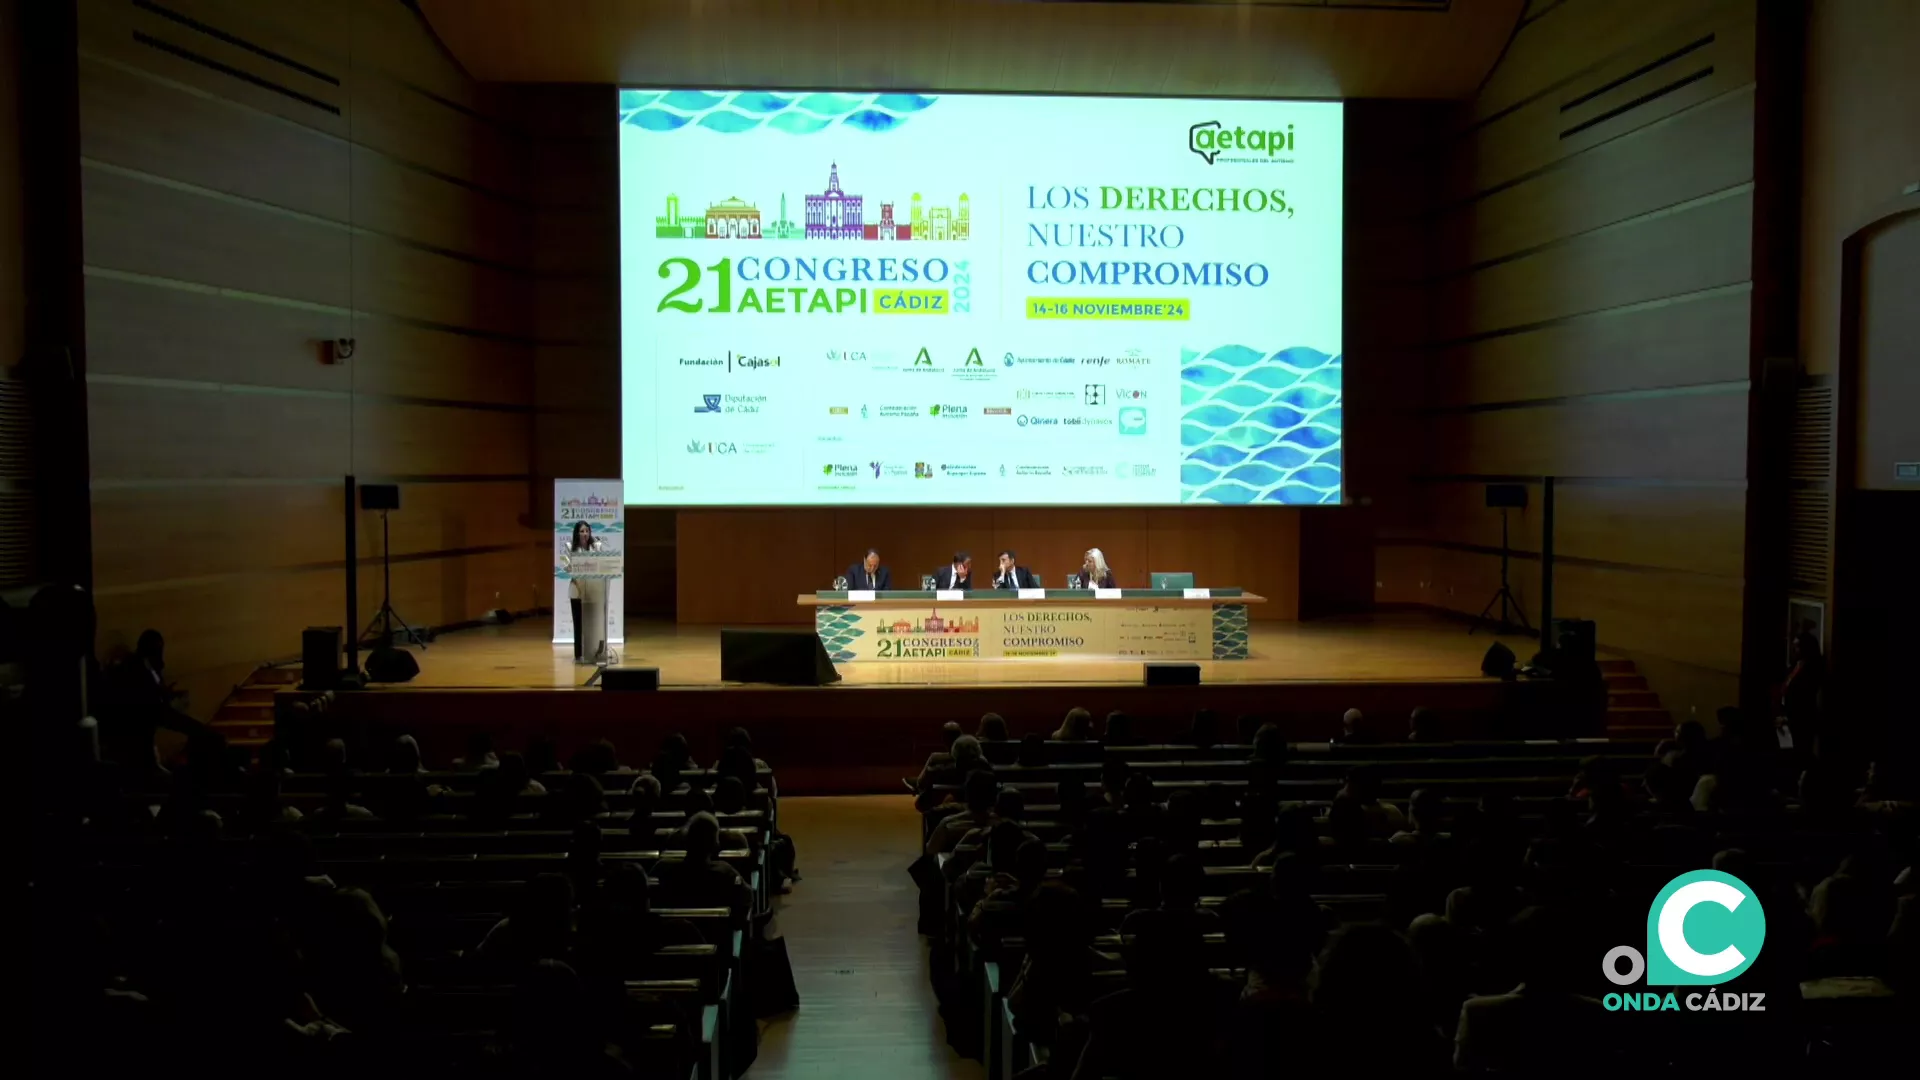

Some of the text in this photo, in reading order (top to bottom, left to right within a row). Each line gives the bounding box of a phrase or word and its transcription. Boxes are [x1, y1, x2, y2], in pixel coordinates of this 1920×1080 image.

[1195, 124, 1294, 156] aetapi
[1028, 185, 1294, 219] LOS DERECHOS,
[1027, 223, 1185, 248] NUESTRO
[737, 256, 949, 282] CONGRESO
[1027, 260, 1269, 287] COMPROMISO
[657, 257, 731, 313] 21
[953, 260, 971, 312] 2024
[737, 288, 943, 313] AETAPI CÁDIZ
[1033, 303, 1068, 315] 14-16
[738, 356, 780, 370] Cajasol
[1081, 356, 1110, 367] renfe
[942, 404, 968, 413] Plena
[1003, 612, 1093, 622] LOS DERECHOS,
[1004, 625, 1056, 634] NUESTRO
[877, 638, 901, 658] 21
[903, 638, 972, 647] CONGRESO
[1003, 637, 1084, 647] COMPROMISO
[903, 648, 945, 657] AETAPI
